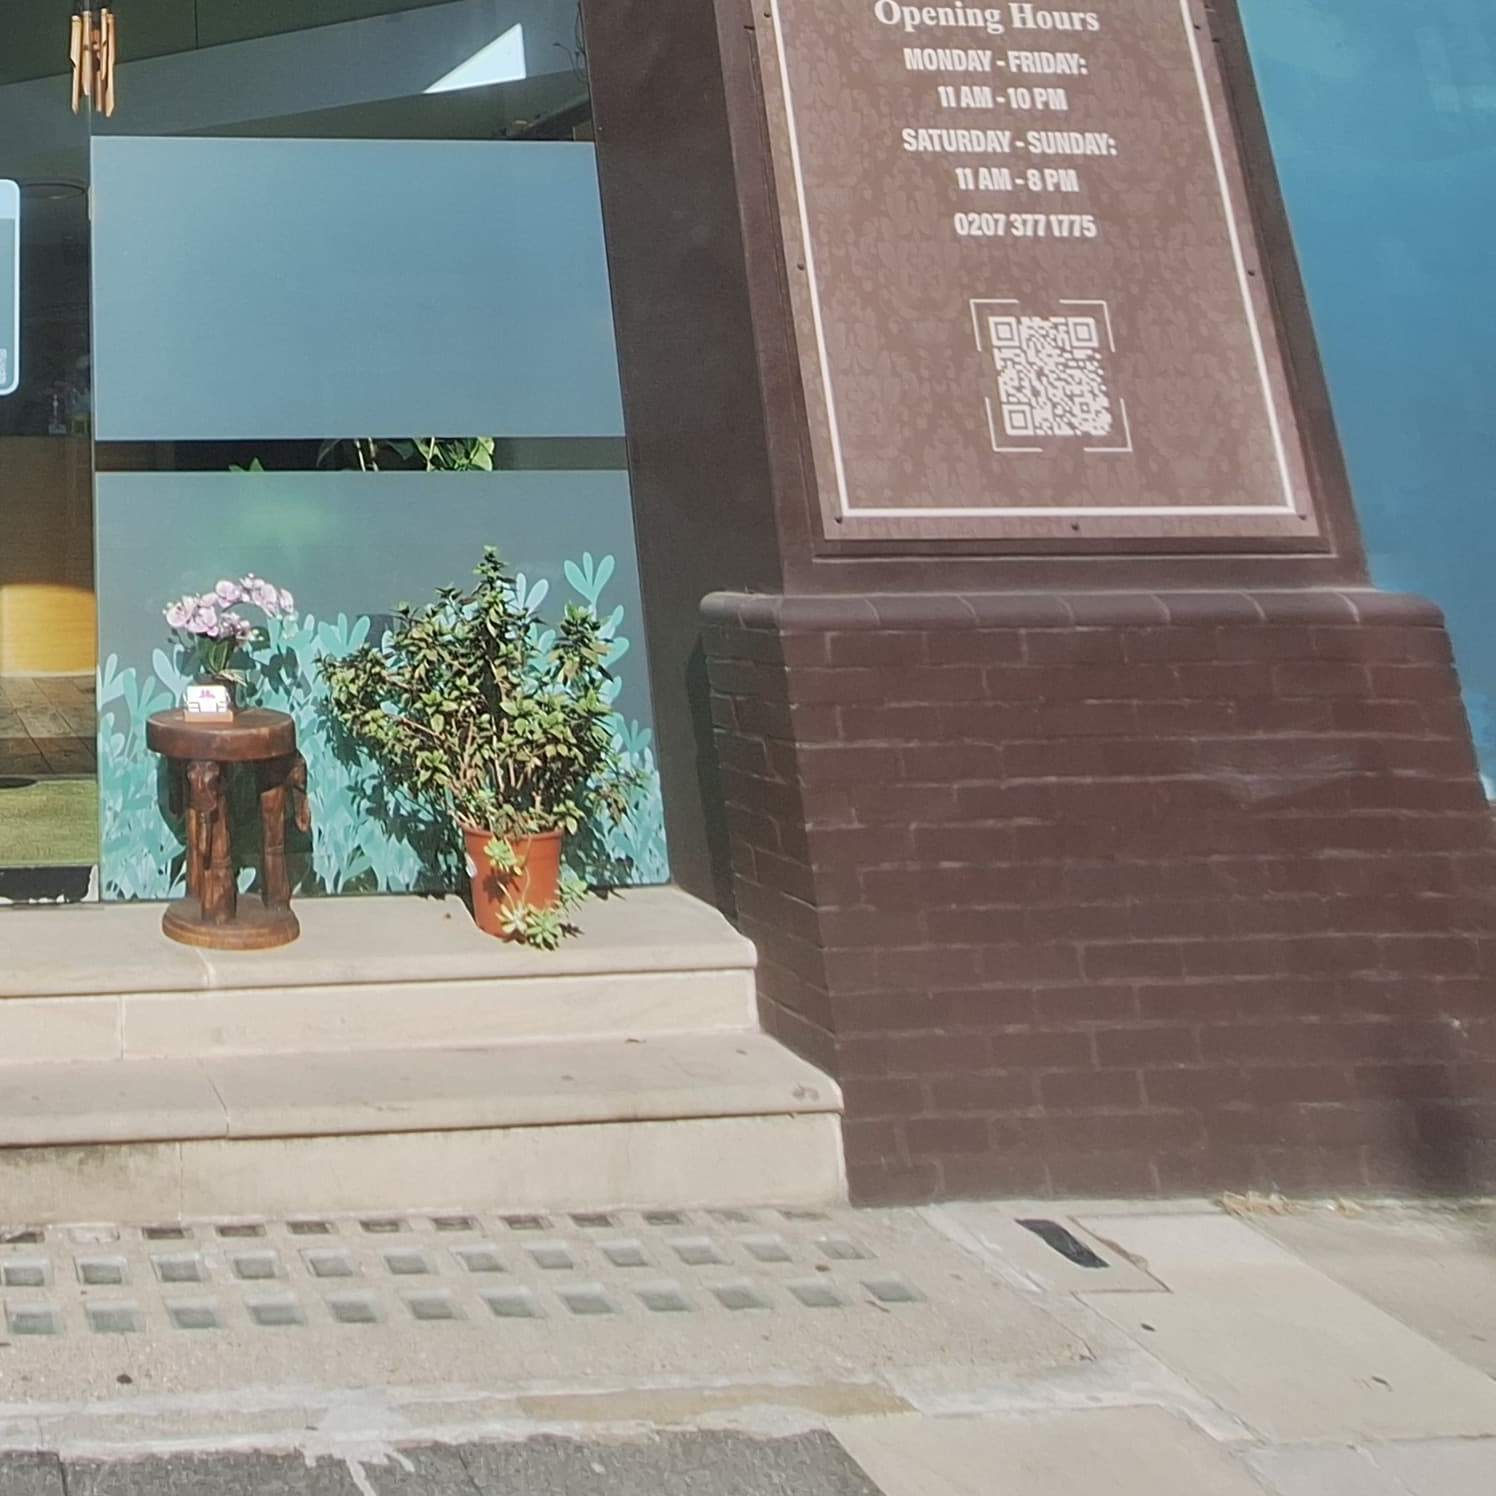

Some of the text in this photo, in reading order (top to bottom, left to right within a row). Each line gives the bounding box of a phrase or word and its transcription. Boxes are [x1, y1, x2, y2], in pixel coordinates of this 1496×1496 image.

[1008, 2, 1100, 31] Hours
[903, 48, 992, 72] MONDAY
[1007, 51, 1088, 75] FRIDAY:
[937, 86, 957, 108] 11
[960, 86, 994, 109] AM
[1007, 87, 1031, 110] 10
[1034, 87, 1068, 110] PM
[902, 128, 1011, 153] SATURDAY
[1026, 131, 1118, 156] SUNDAY:
[955, 167, 975, 190] 11
[979, 167, 1013, 191] AM
[1026, 169, 1043, 192] 8
[1044, 169, 1079, 192] PM
[954, 212, 1097, 238] 0207 377 1775
